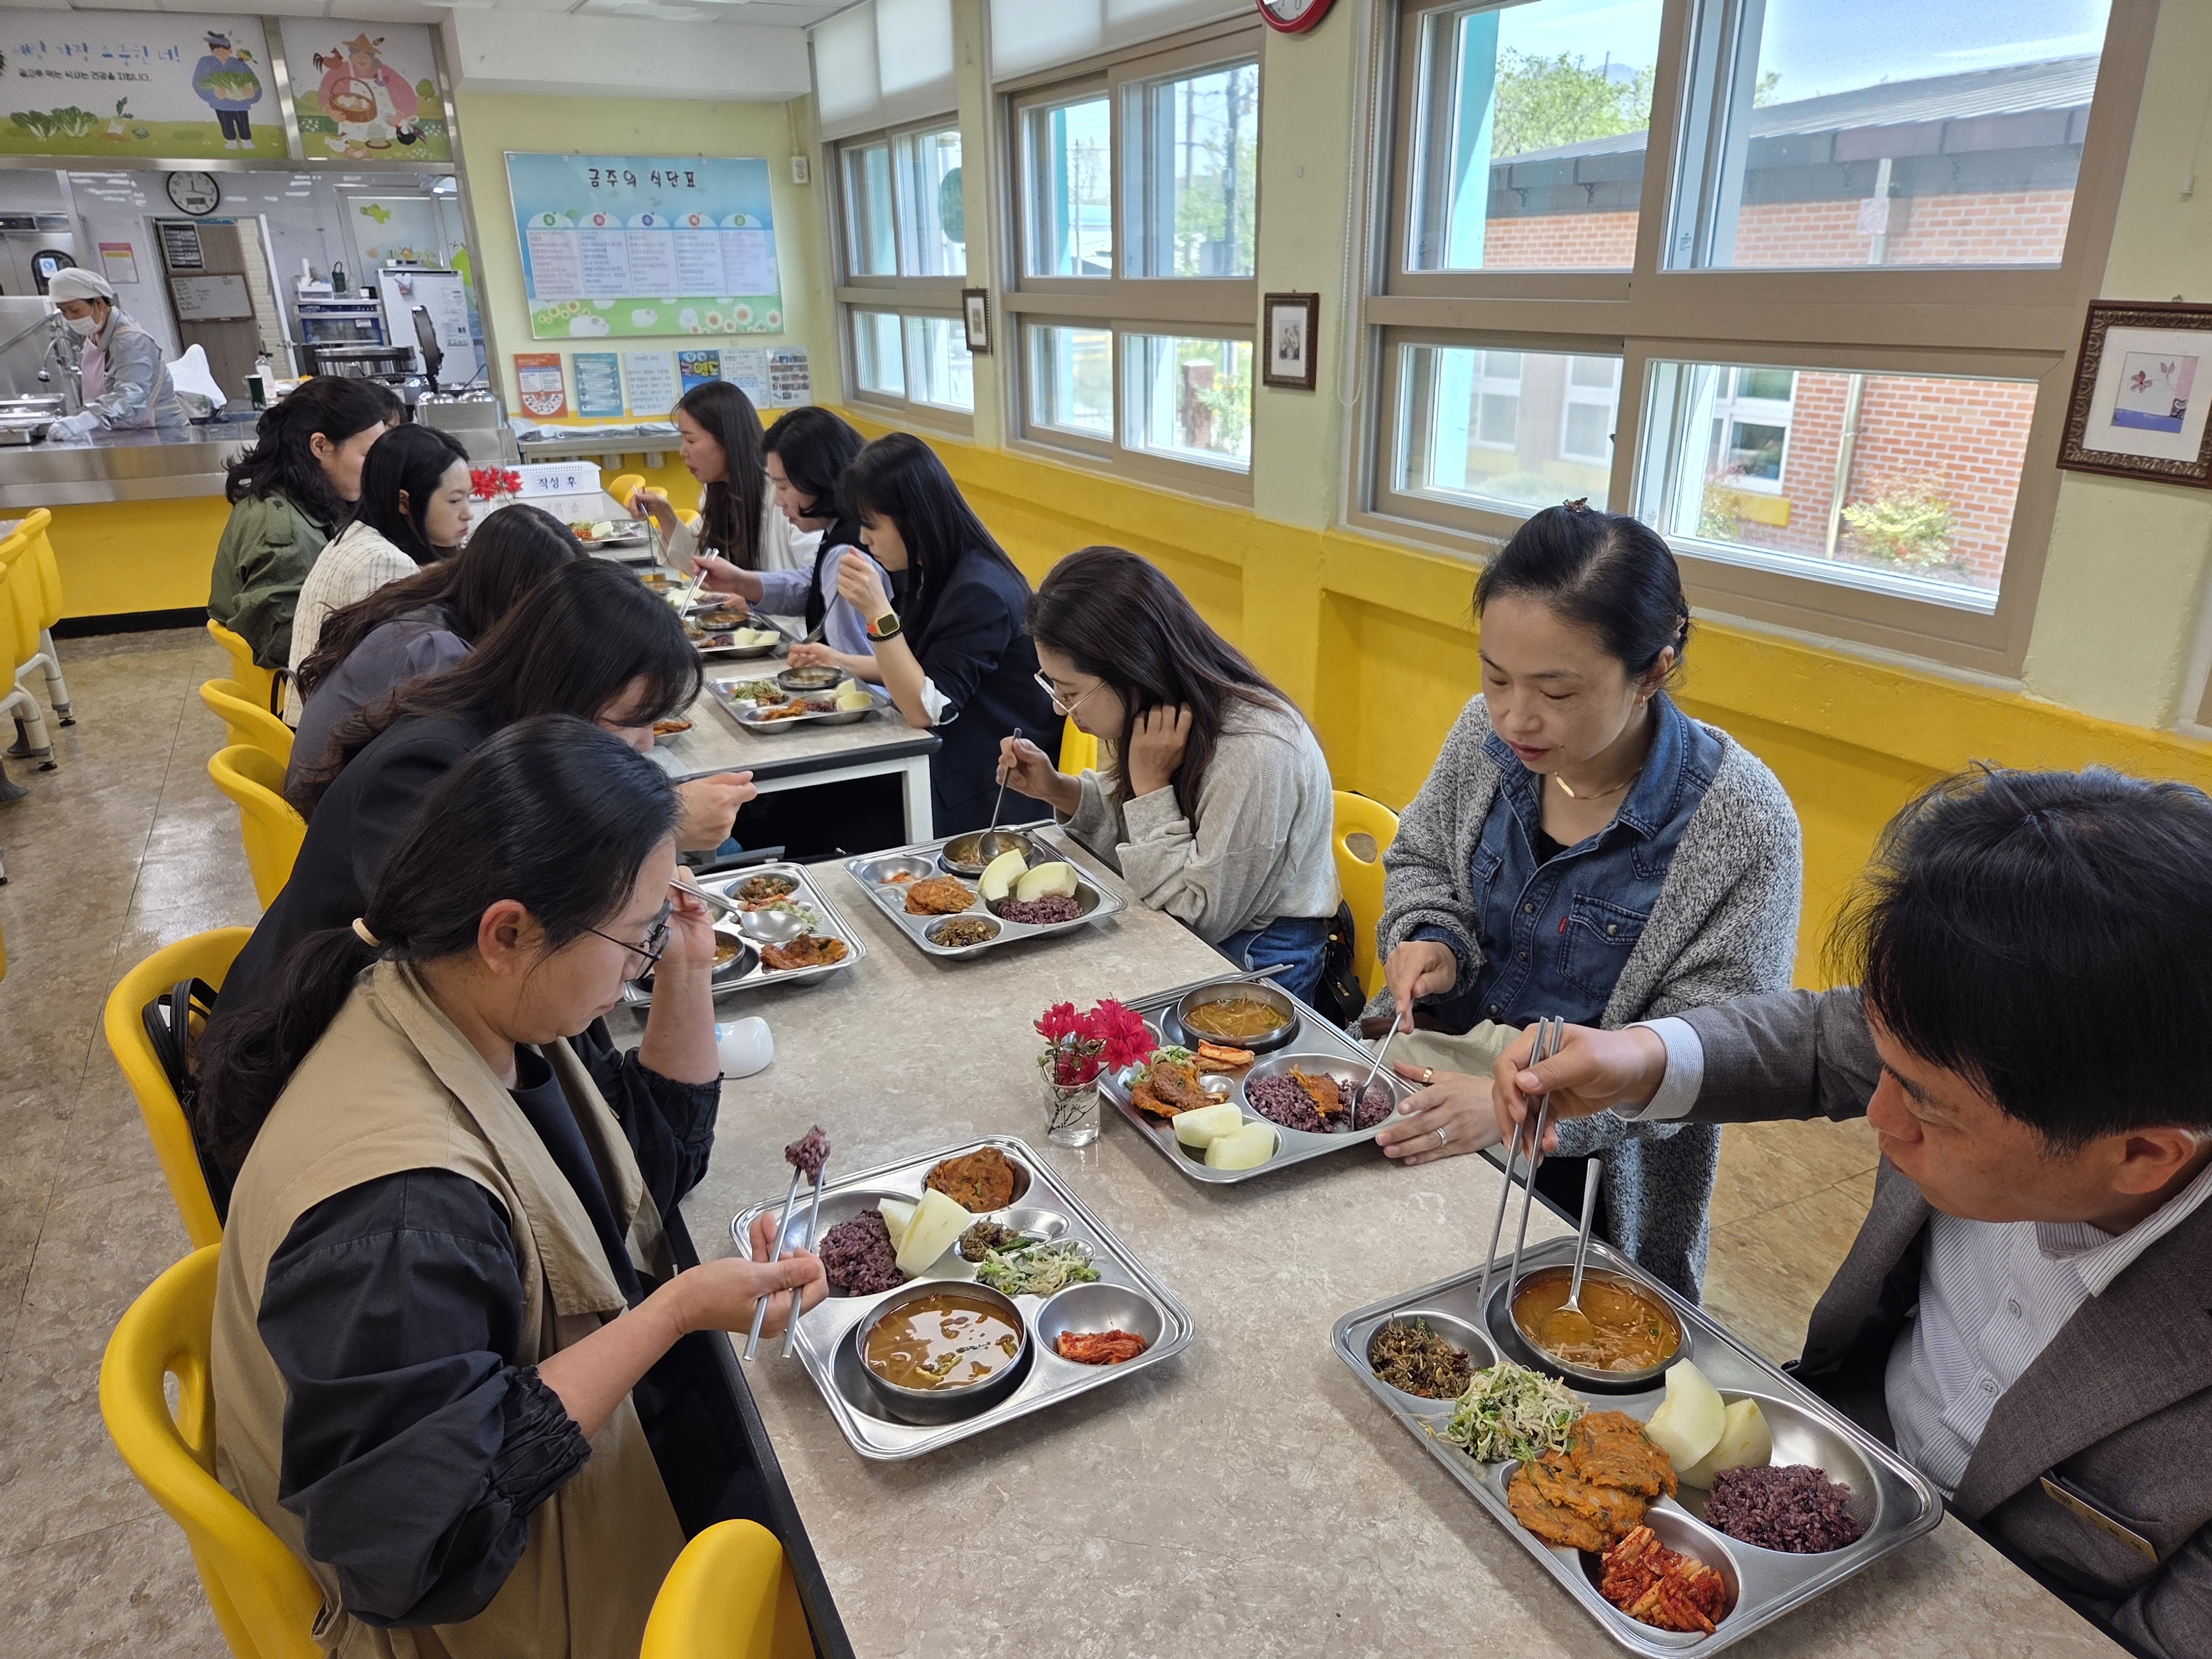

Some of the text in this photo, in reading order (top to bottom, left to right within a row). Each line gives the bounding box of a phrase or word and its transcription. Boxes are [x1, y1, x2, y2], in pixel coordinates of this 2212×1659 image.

[13, 40, 46, 61] 세상
[56, 41, 88, 62] 가장
[102, 44, 150, 66] 소중한
[588, 168, 696, 188] 금주의 식단표
[566, 476, 577, 488] 후
